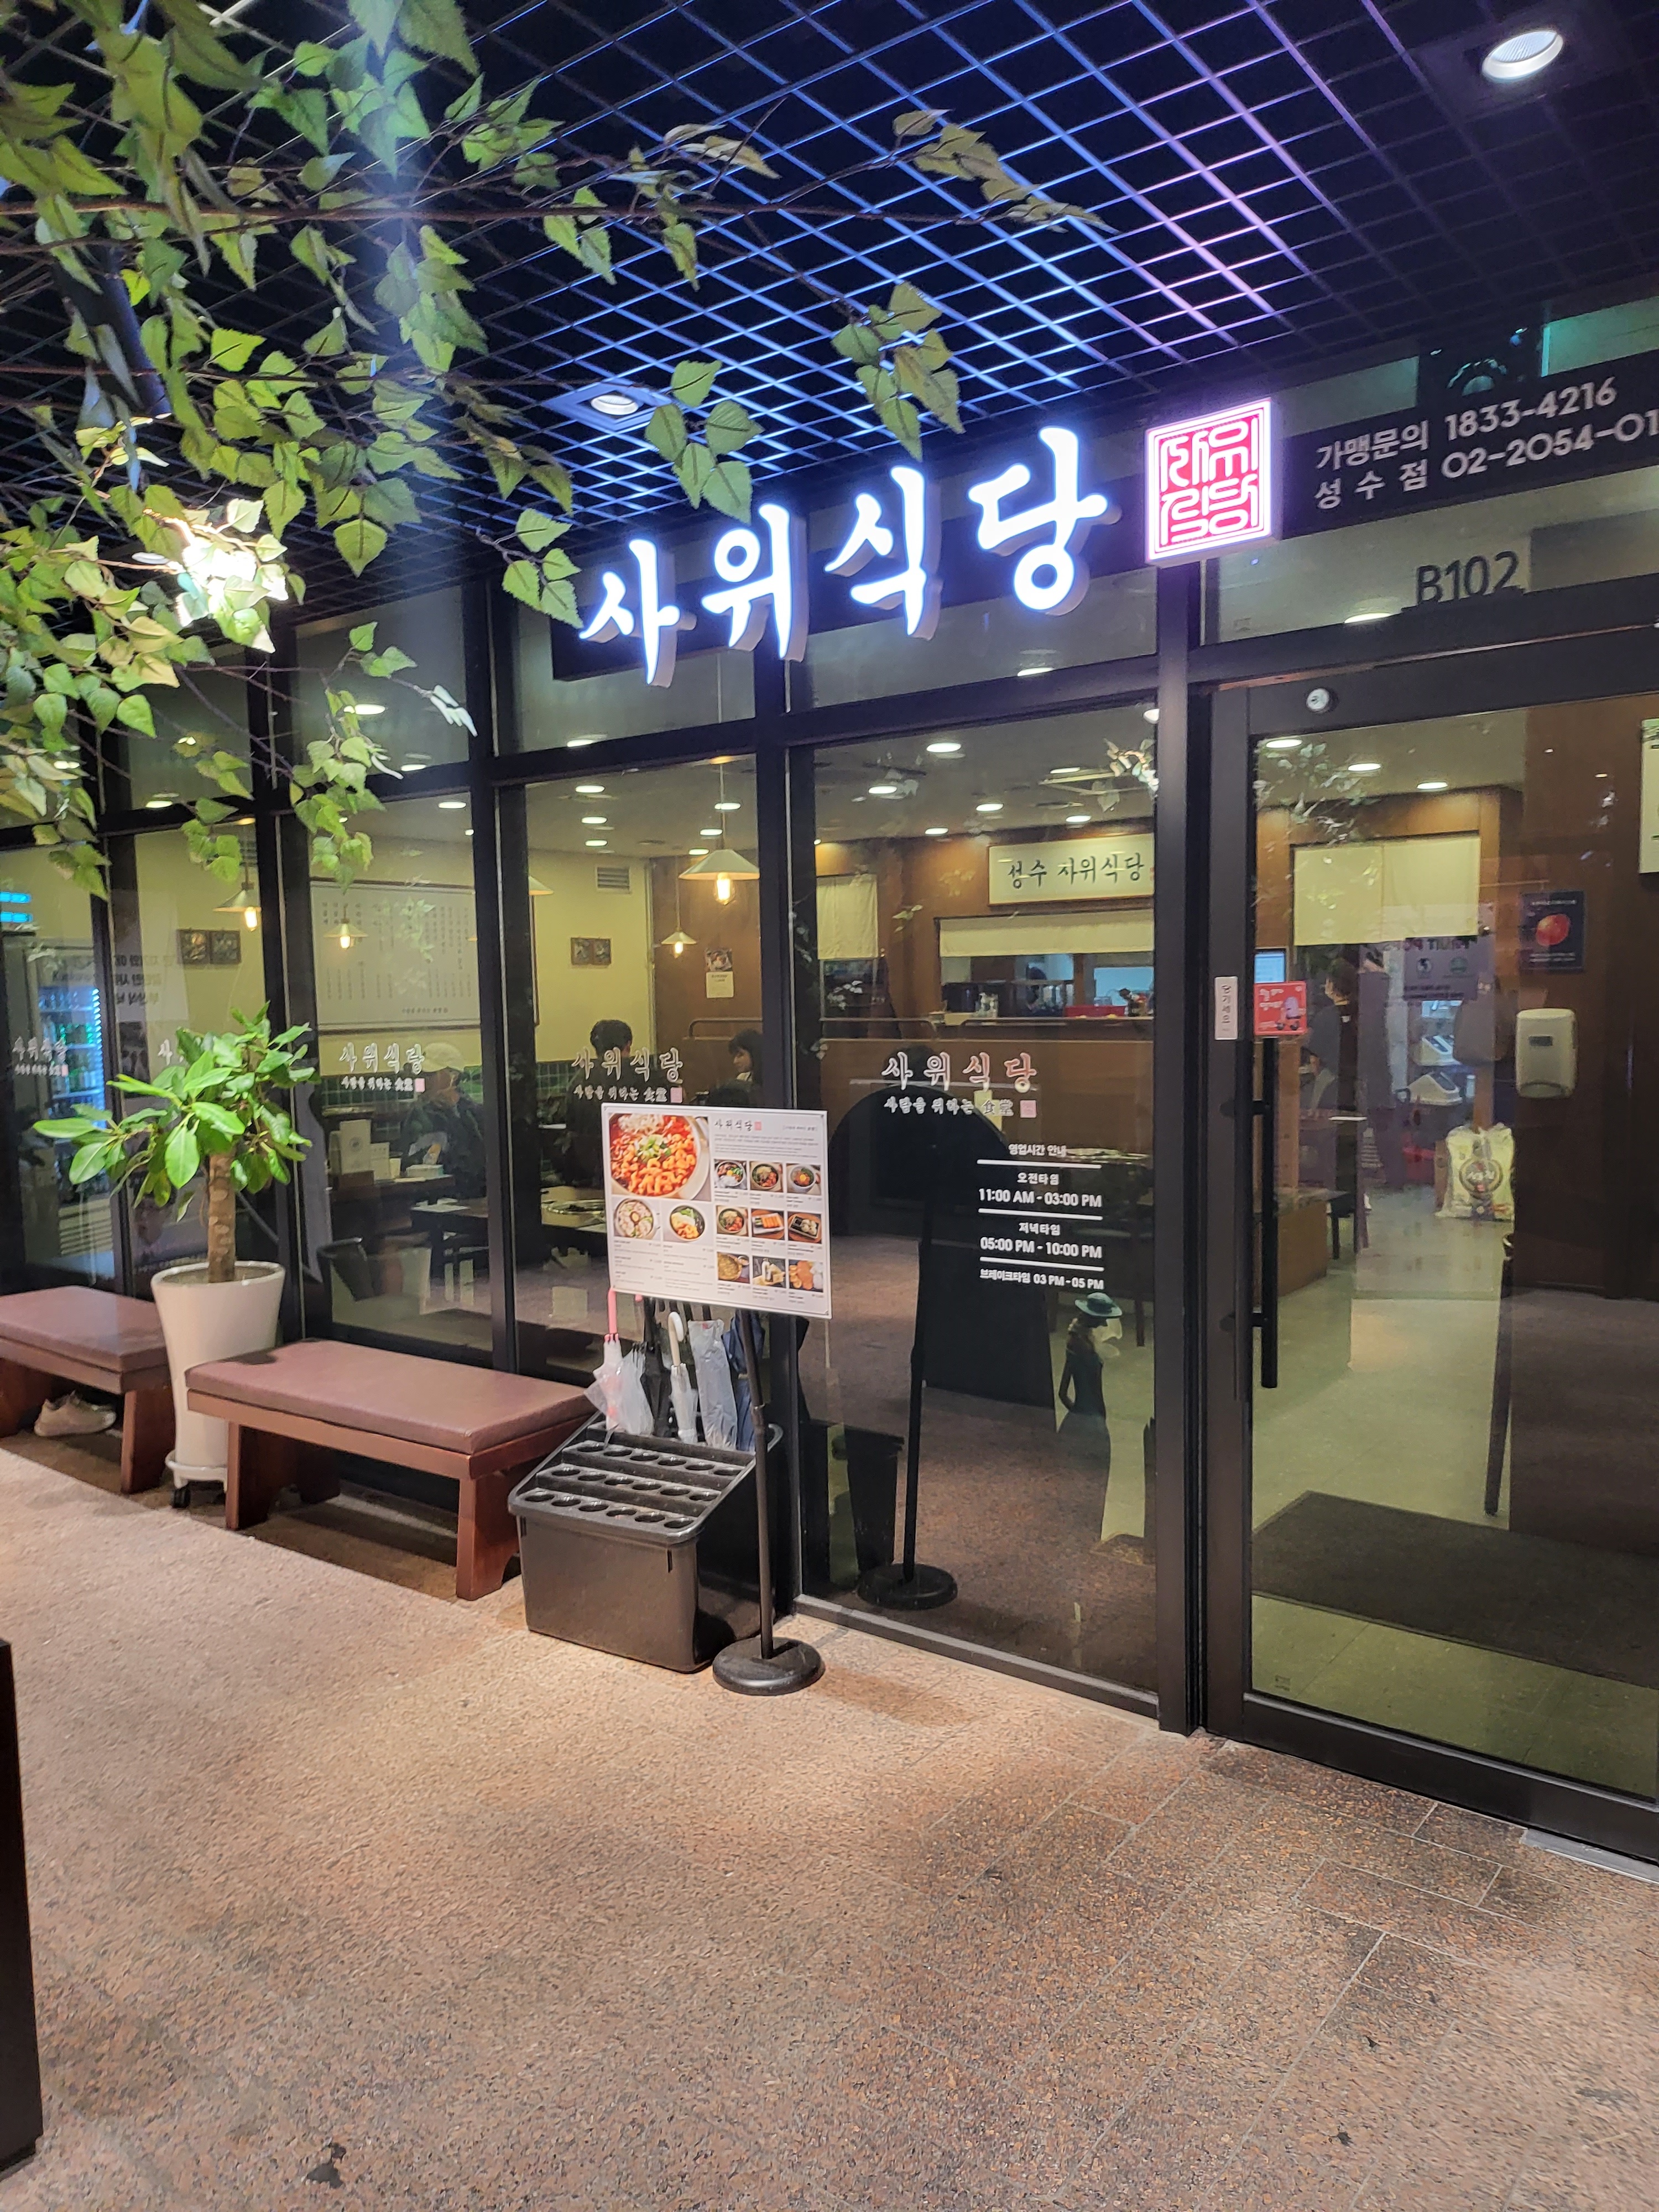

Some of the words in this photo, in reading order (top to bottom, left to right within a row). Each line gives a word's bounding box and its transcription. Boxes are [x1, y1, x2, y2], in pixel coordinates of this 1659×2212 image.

[1316, 419, 1430, 471] 가맹문의
[1445, 377, 1618, 441] 1833-4216
[1441, 409, 1659, 479] 02-2054-01
[578, 426, 1109, 686] 사위식당
[1416, 551, 1519, 604] B102
[1008, 859, 1047, 889] 성수
[1057, 852, 1145, 885] 사위식당
[571, 1046, 684, 1083] 사위식당
[881, 1051, 1037, 1093] 사위식당
[1008, 1143, 1046, 1156] 영업시간
[1047, 1144, 1067, 1157] 안내
[1017, 1172, 1060, 1185] 오전타임
[978, 1188, 1011, 1202] 11:00
[1013, 1191, 1035, 1203] AM
[1044, 1192, 1078, 1206] 03:00
[1081, 1194, 1102, 1207] PM
[1019, 1222, 1061, 1235] 저녁타임
[980, 1237, 1013, 1251] 05:00
[1015, 1239, 1035, 1253] PM
[1045, 1242, 1078, 1256] 10:00
[1081, 1245, 1102, 1259] PM
[979, 1269, 1031, 1284] 브레이크타임
[1033, 1274, 1047, 1284] 03
[1087, 1279, 1104, 1290] PM
